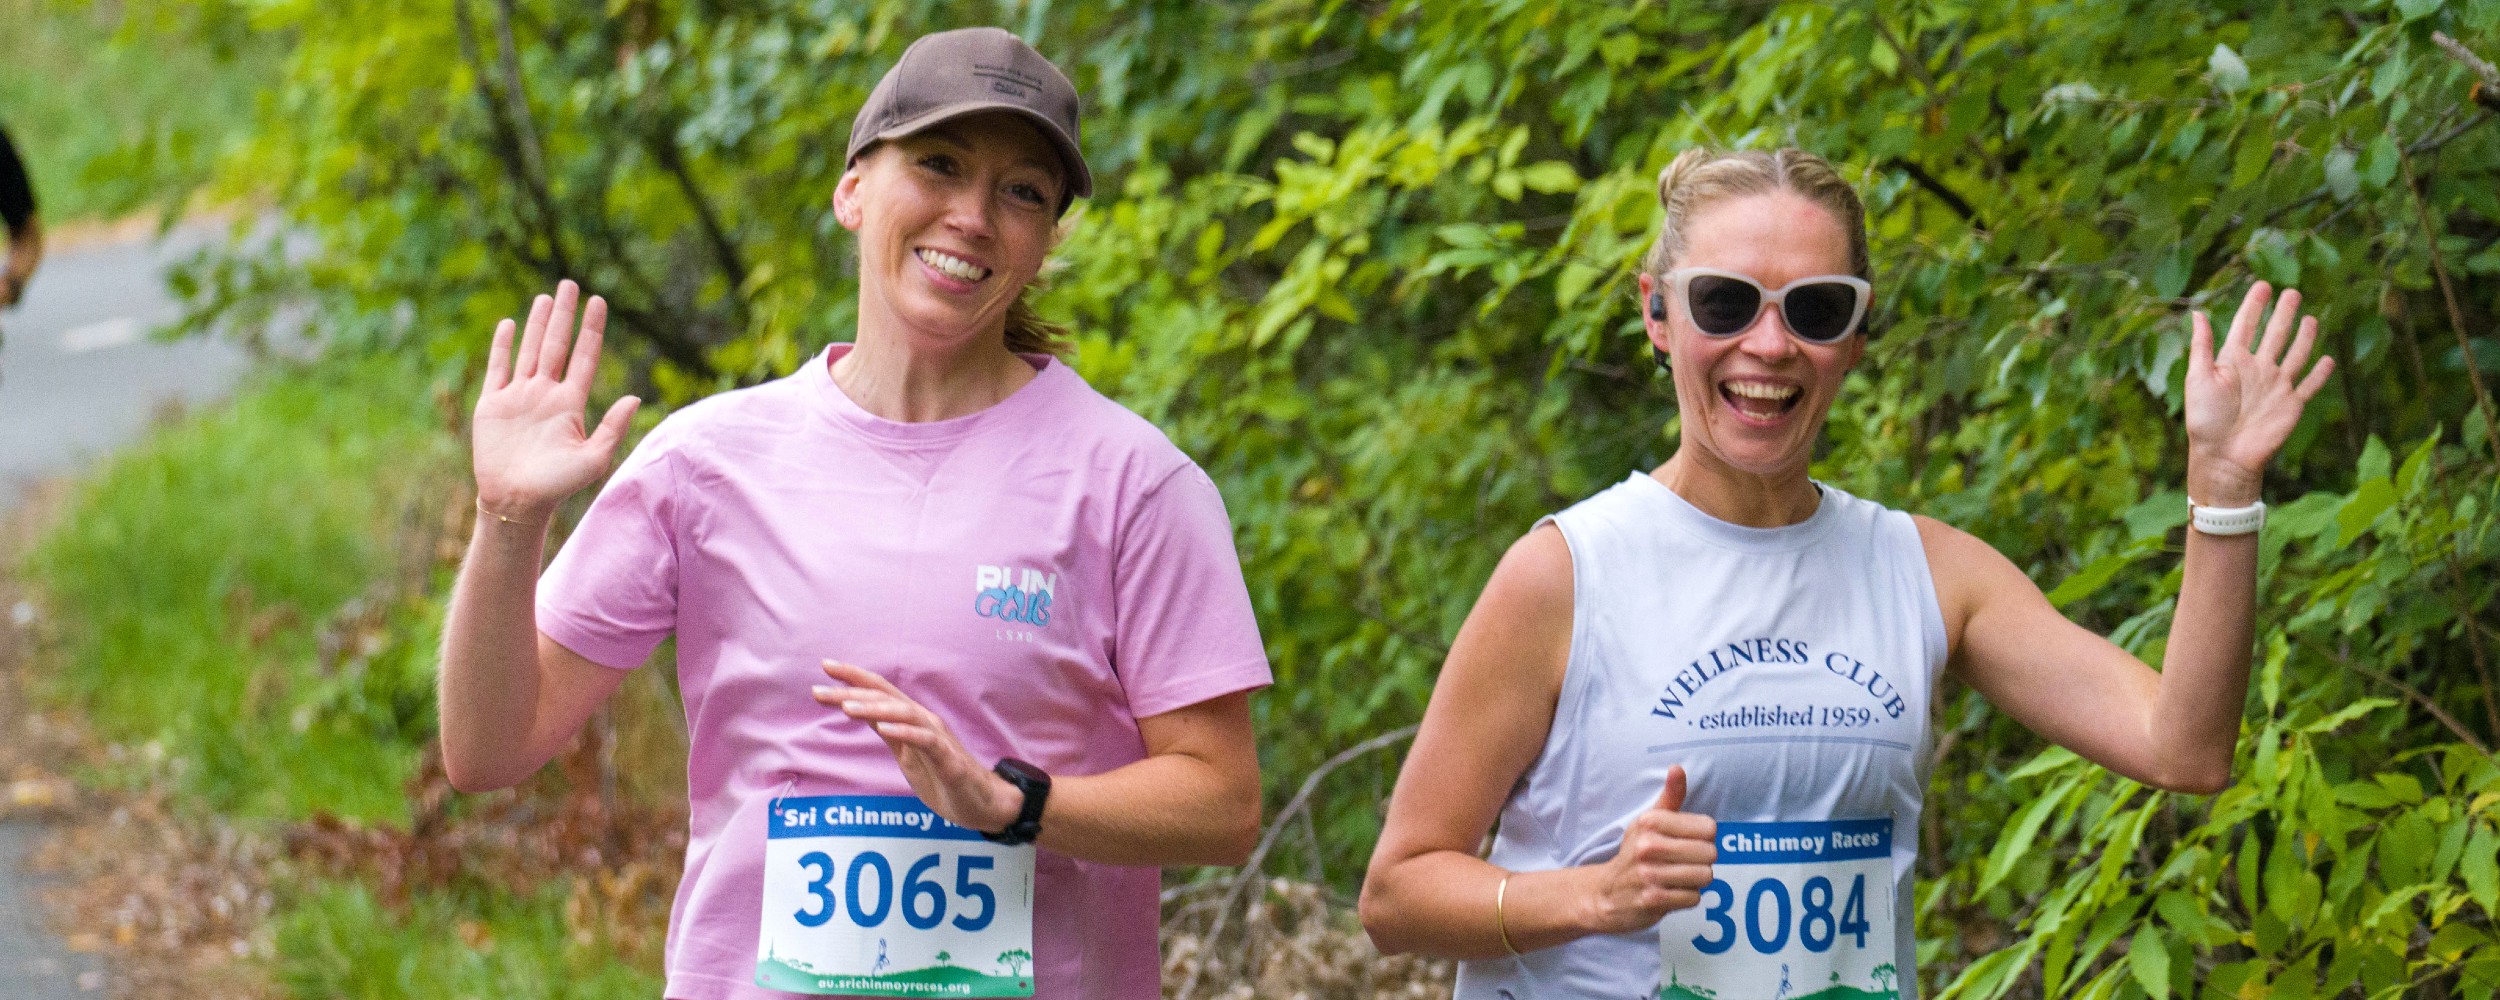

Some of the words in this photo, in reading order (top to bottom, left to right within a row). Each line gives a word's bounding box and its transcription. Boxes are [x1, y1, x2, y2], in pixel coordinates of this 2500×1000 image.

[976, 565, 1057, 599] RUN
[1650, 637, 1809, 720] WELLNESS
[1824, 651, 1906, 720] CLUB
[1699, 704, 1814, 730] established
[1821, 706, 1872, 728] 1959
[783, 807, 817, 827] Sri
[824, 806, 935, 831] Chinmoy
[1721, 832, 1826, 856] Chinmoy
[1831, 831, 1881, 849] Races
[793, 850, 997, 932] 3065
[1690, 872, 1870, 955] 3084
[817, 977, 971, 994] au.srichinmoyraces.org
